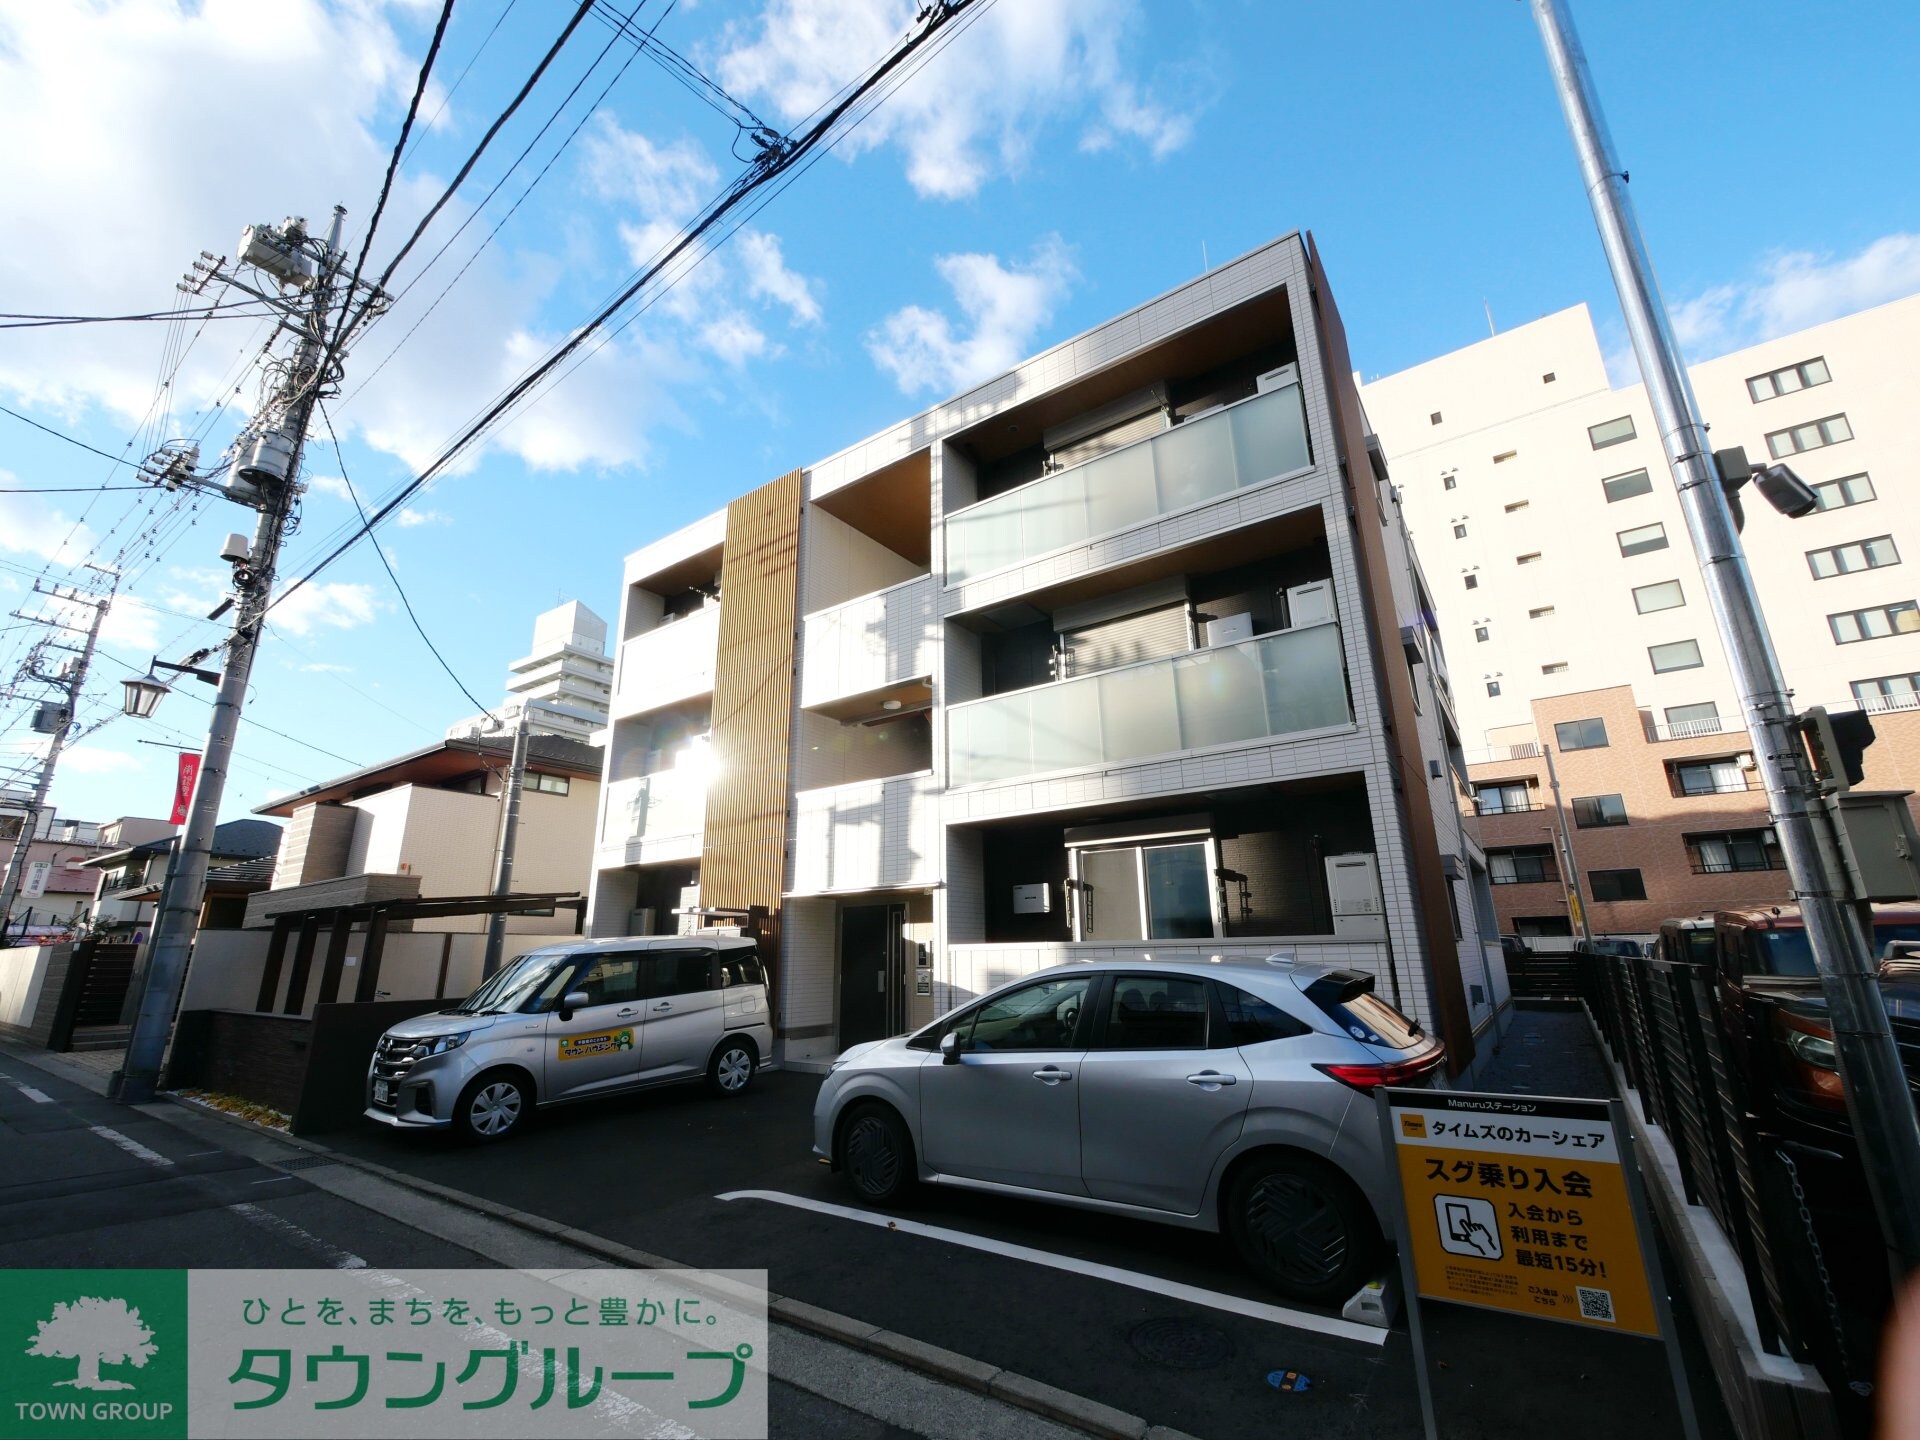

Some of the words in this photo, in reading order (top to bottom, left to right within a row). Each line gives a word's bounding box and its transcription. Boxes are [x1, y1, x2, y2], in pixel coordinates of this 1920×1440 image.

[1432, 1121, 1605, 1149] タイムズのカーシェア
[1425, 1158, 1593, 1198] スグ乗り入会
[1508, 1203, 1583, 1226] 入会から
[1511, 1226, 1588, 1251] 利用まで
[1528, 1286, 1558, 1297] ご入会は
[1534, 1296, 1556, 1306] こちら
